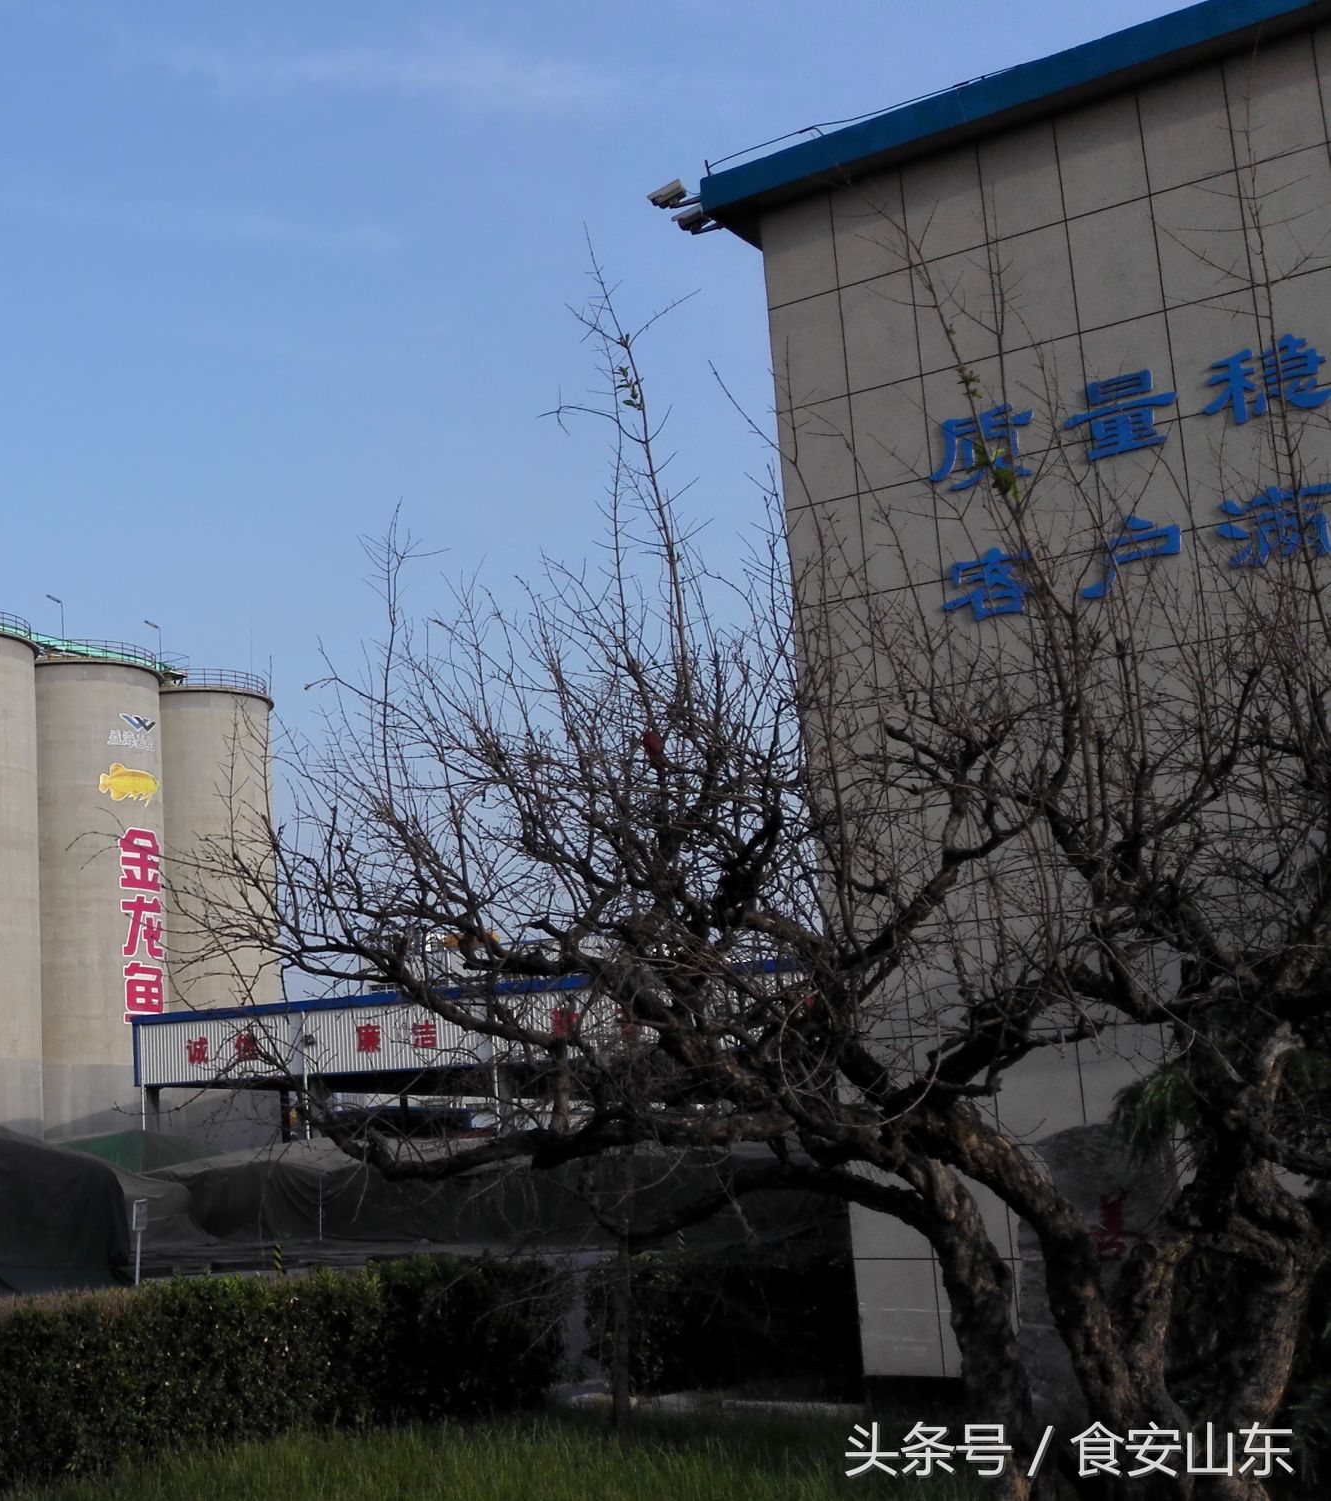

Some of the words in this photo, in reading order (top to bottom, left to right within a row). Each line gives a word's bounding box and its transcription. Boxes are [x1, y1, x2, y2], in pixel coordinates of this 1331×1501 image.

[929, 333, 1331, 491] 质量稳
[943, 482, 1331, 621] 客户满
[119, 827, 164, 1024] 金龙鱼
